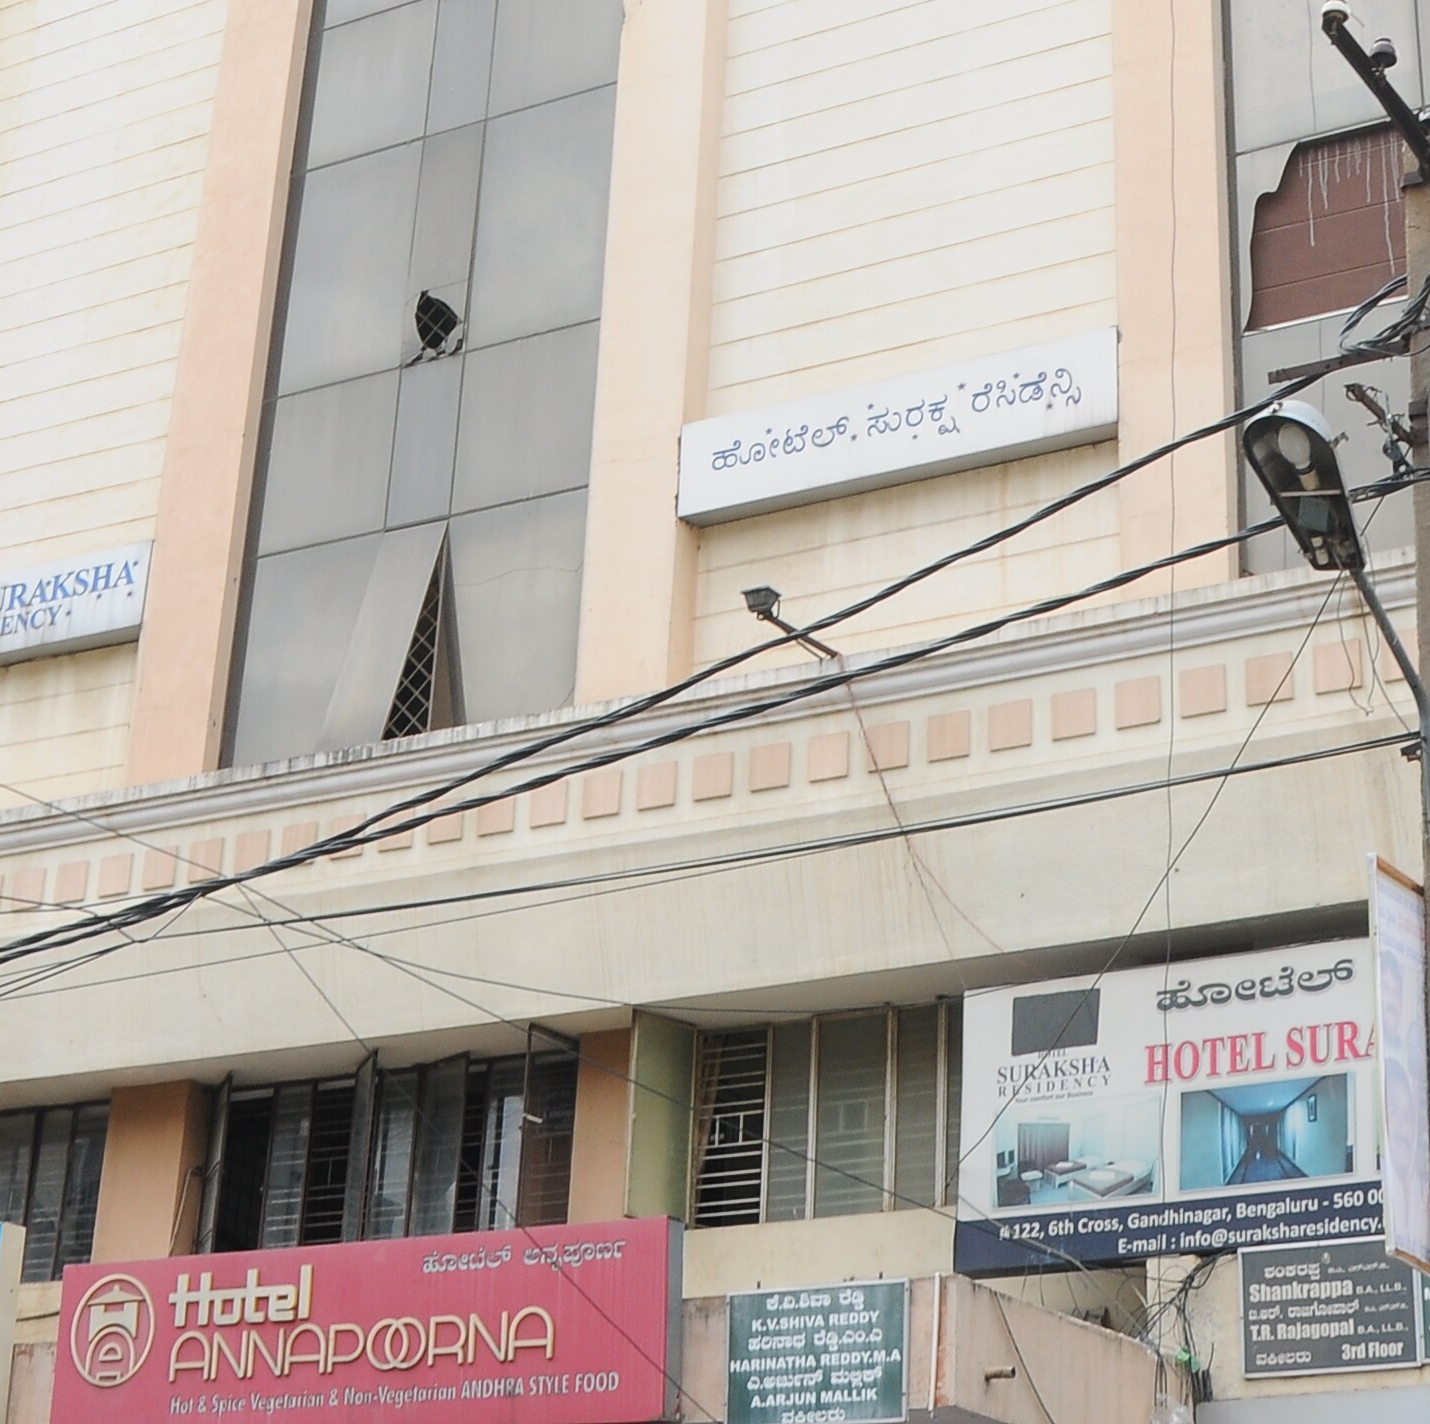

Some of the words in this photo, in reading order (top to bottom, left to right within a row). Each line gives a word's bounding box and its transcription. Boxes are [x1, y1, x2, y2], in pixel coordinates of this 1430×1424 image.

[711, 415, 850, 471] ಹೋಟೆಲ್
[1156, 958, 1355, 1014] ಹೋಟೆಲ್
[997, 1056, 1111, 1084] SURAKSHA
[1144, 1030, 1276, 1085] HOTEL
[998, 1074, 1111, 1098] RESIDENCY
[1048, 1218, 1074, 1236] 6th
[1077, 1217, 1123, 1234] Cross,
[1127, 1207, 1232, 1230] Gandhinagar,
[1236, 1196, 1318, 1221] Bengaluru
[1333, 1190, 1364, 1209] 560
[1118, 1234, 1167, 1254] E-mail
[422, 1244, 512, 1274] ಹೋಟೆಲ್
[168, 1263, 313, 1328] Hotel
[1249, 1279, 1353, 1302] Shankrappa
[751, 1314, 825, 1333] K.V.SHIVA
[829, 1310, 880, 1327] REDDY
[1249, 1324, 1275, 1342] T.R.
[1277, 1319, 1355, 1341] Rajagopal
[168, 1305, 555, 1383] ANNAPOORNA
[1341, 1342, 1367, 1360] 3rd
[1368, 1341, 1404, 1358] Floor
[729, 1354, 816, 1373] HARINATHA
[169, 1396, 194, 1415] Hot
[197, 1395, 207, 1412] &
[211, 1393, 247, 1416] Spice
[250, 1389, 325, 1415] Vegetarian
[329, 1387, 339, 1406] &
[344, 1381, 457, 1409] Non-Vegetarian
[460, 1377, 524, 1400] ANDHRA
[528, 1374, 570, 1397] STYLE
[573, 1371, 620, 1393] FOOD
[750, 1391, 816, 1409] A.ARJUN
[820, 1387, 878, 1404] MALLIK
